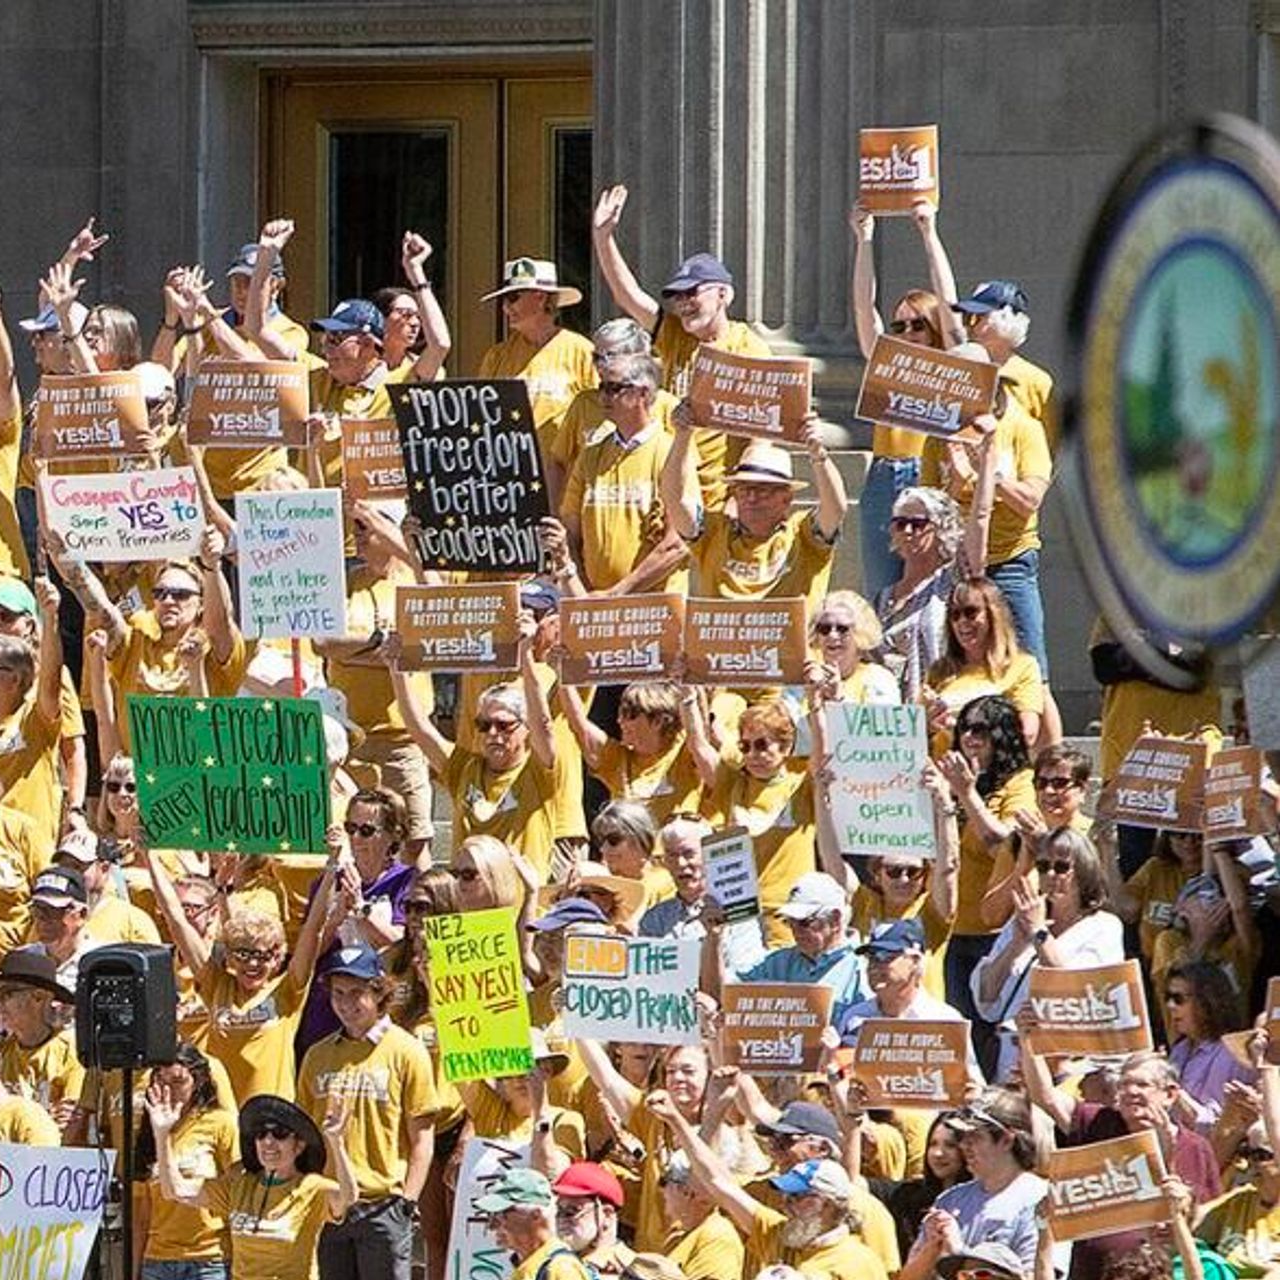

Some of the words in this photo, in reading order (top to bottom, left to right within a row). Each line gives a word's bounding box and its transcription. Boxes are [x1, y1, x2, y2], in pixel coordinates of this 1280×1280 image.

[408, 384, 502, 430] more
[210, 413, 253, 431] YES!
[53, 428, 94, 446] YES!
[403, 422, 540, 477] freedom
[430, 475, 526, 516] better
[118, 501, 165, 530] YES
[297, 568, 329, 587] here
[286, 608, 334, 631] VOTE
[420, 636, 464, 654] YES!
[585, 649, 632, 668] YES!
[706, 653, 753, 670] YES!
[207, 700, 324, 769] freedom
[843, 703, 919, 738] VALLEY
[836, 740, 915, 772] County
[426, 915, 465, 940] NEZ
[445, 933, 506, 964] PERCE
[568, 938, 623, 972] END
[628, 942, 679, 975] THE
[434, 973, 466, 1005] SAY
[471, 962, 518, 1001] YES!
[565, 983, 632, 1021] CLOSED
[1033, 995, 1092, 1020] YES!
[450, 1016, 479, 1038] TO
[738, 1040, 778, 1057] YES!
[877, 1075, 920, 1092] YES!
[24, 1164, 108, 1212] CLOSED
[1049, 1172, 1109, 1204] YES!
